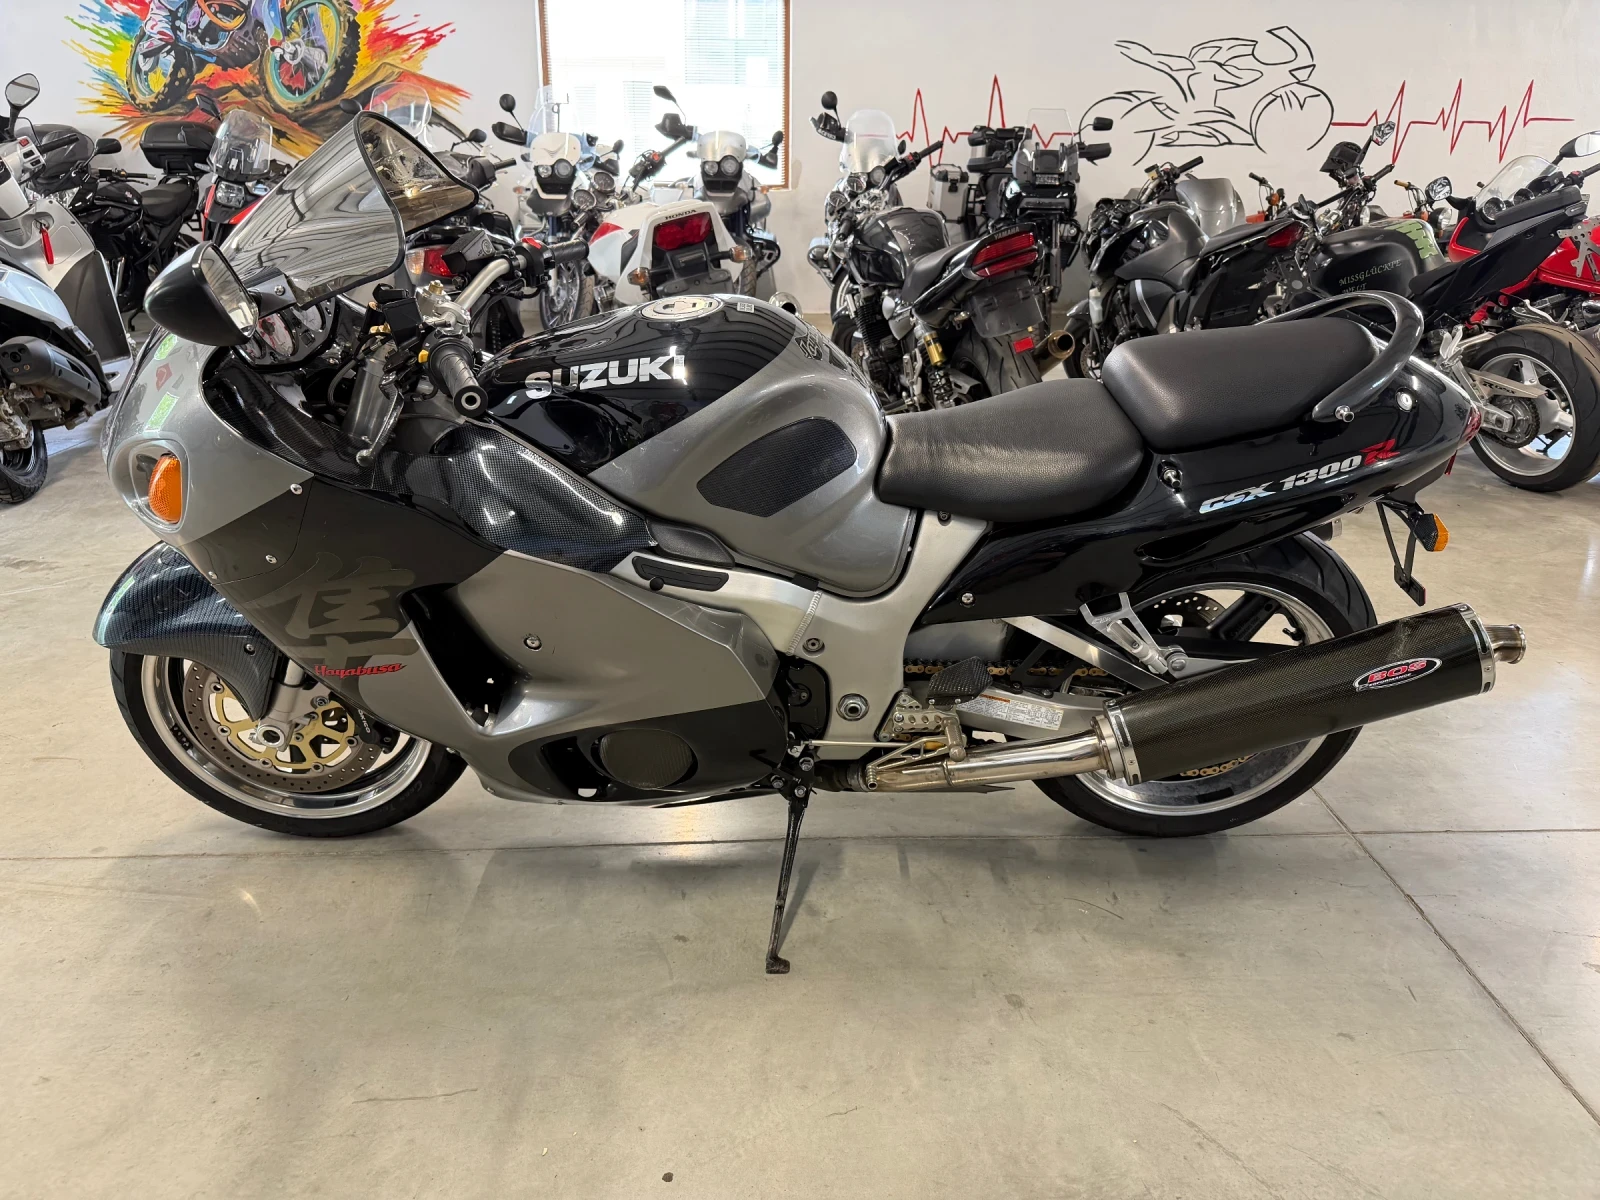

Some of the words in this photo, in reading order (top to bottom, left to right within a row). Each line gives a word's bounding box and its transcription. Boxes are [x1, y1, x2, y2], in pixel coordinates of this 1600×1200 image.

[665, 209, 697, 221] HONDA
[994, 226, 1020, 240] YAMAHA
[524, 354, 686, 399] SUZUKI
[1199, 481, 1277, 514] GSX
[314, 662, 408, 679] Hayabusa
[1367, 660, 1427, 683] BOS
